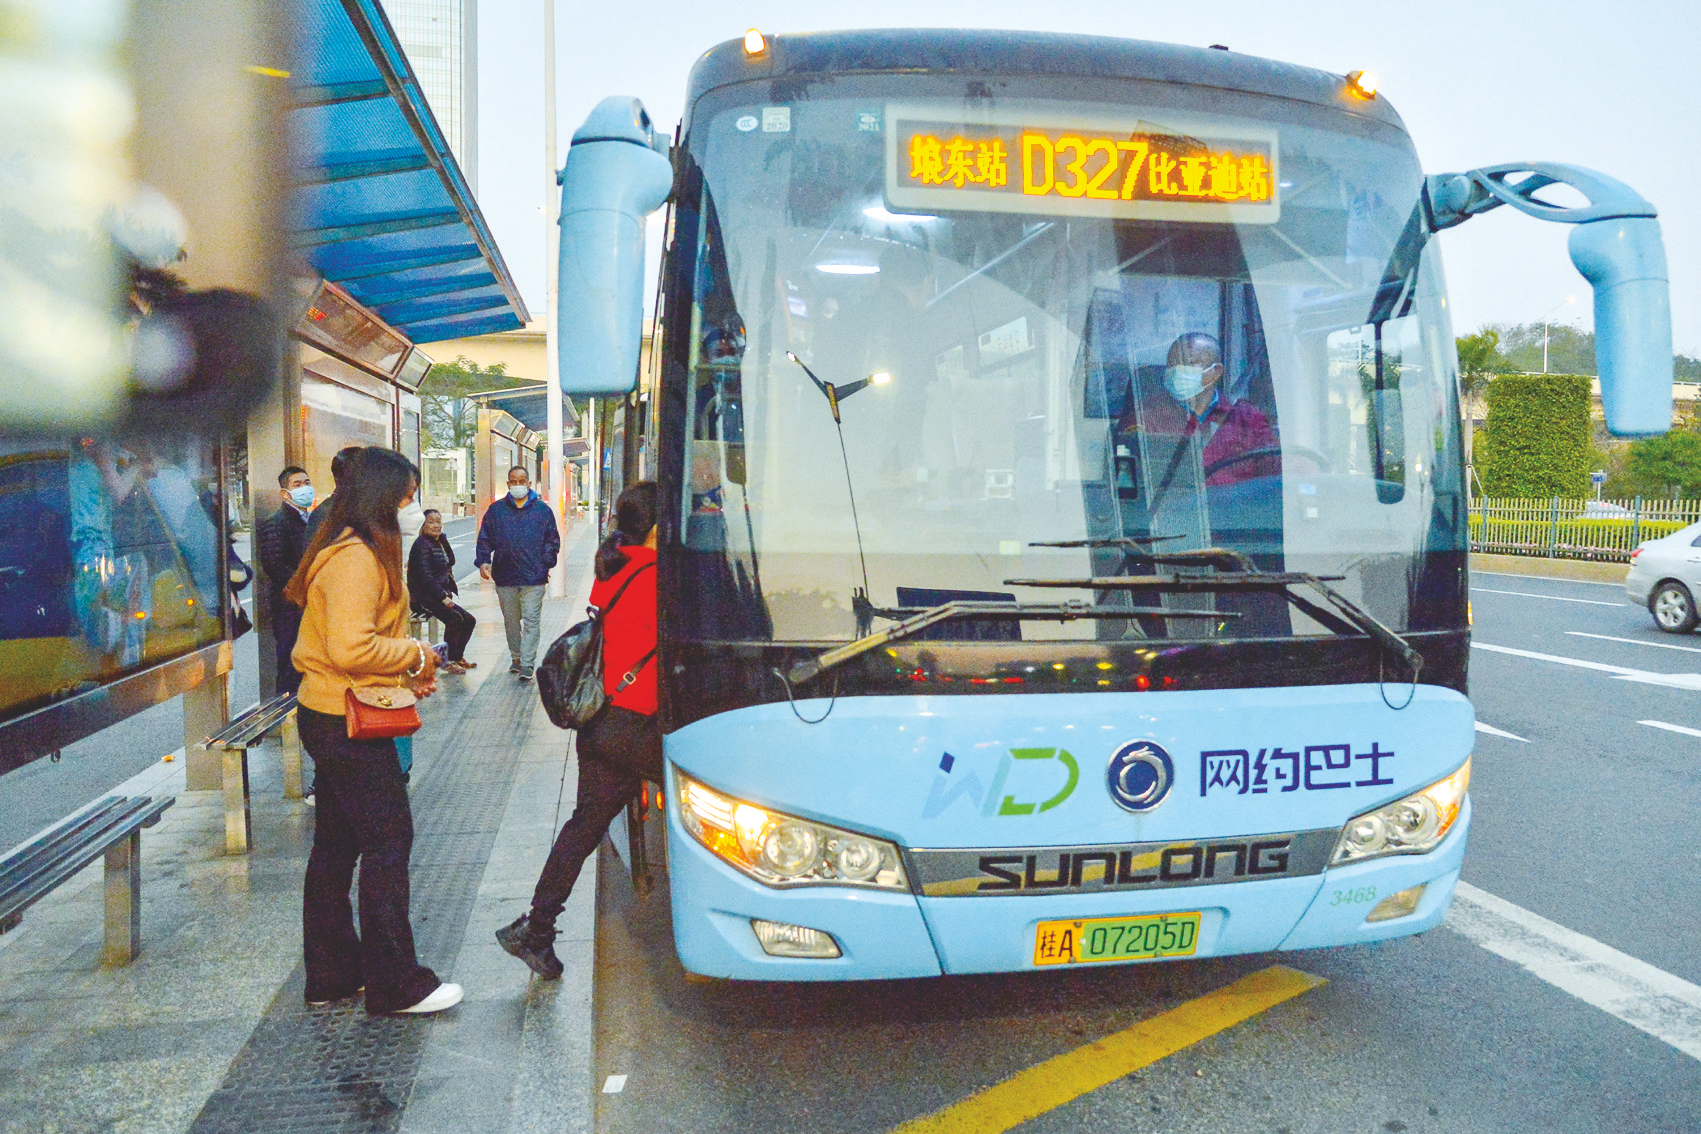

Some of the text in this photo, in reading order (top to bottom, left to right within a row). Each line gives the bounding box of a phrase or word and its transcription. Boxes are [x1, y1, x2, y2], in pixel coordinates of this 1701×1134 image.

[1022, 134, 1149, 201] D327
[1149, 151, 1268, 201] 比亚迪站
[1200, 742, 1395, 797] 网约巴士
[977, 840, 1291, 891] SUNLONG
[1330, 885, 1377, 907] 3468
[1040, 921, 1196, 959] 桂A 07205D
